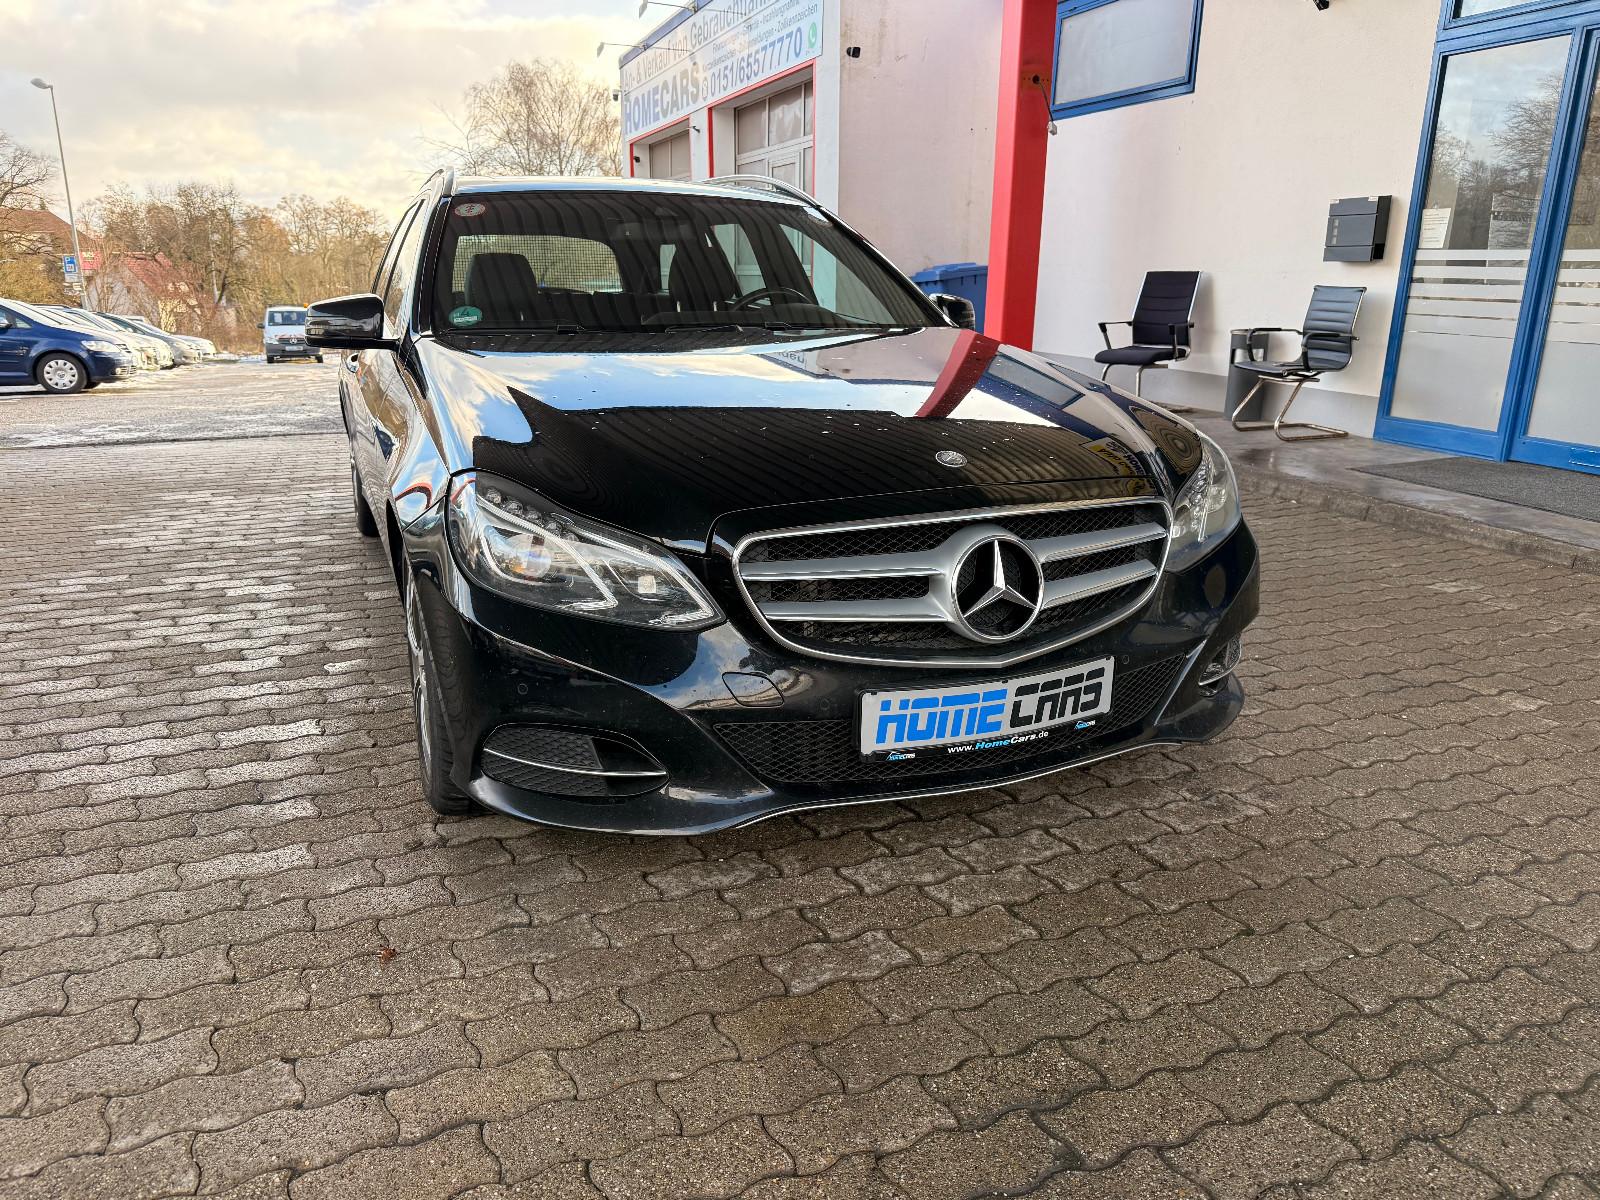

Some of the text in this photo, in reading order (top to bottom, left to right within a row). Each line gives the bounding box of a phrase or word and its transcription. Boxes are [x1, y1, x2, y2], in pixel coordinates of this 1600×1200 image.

[642, 40, 671, 80] Verkauf
[672, 36, 688, 62] von
[947, 730, 1049, 754] www.HomeCars.de
